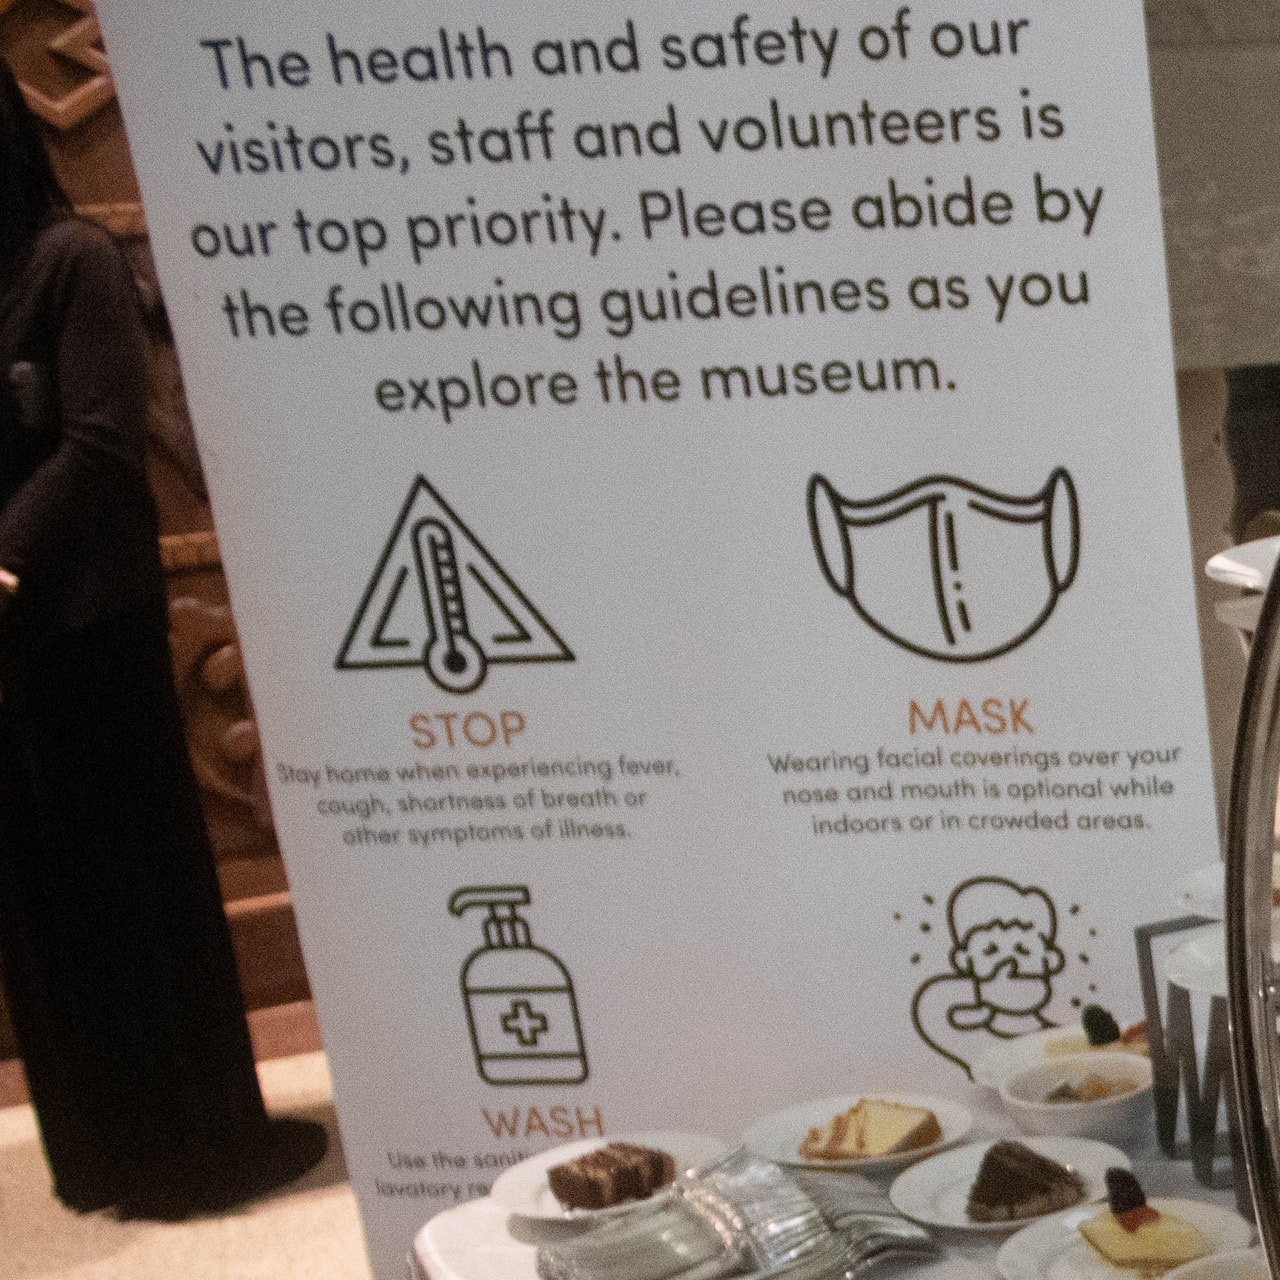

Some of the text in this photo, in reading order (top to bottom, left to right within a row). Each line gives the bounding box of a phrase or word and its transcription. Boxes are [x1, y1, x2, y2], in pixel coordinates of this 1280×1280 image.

[199, 6, 1030, 90] The health and safety of our
[195, 87, 1065, 176] visitors, staff and volunteers is
[190, 172, 1104, 267] our top priority. Please abide by
[222, 265, 1090, 341] the following guidelines as you
[374, 353, 957, 424] explore the museum.
[408, 710, 526, 751] STOP
[909, 697, 1034, 735] MASK
[276, 754, 680, 788] Stay home when experiencing fever,
[767, 746, 1182, 776] Wearing facial coverings over your
[316, 788, 647, 821] cough, shortness of breath or
[782, 776, 1175, 805] nose and mouth is optional while
[342, 818, 629, 848] other symptoms of illness.
[812, 808, 1151, 835] indoors or in crowded areas.
[481, 1105, 605, 1139] WASH
